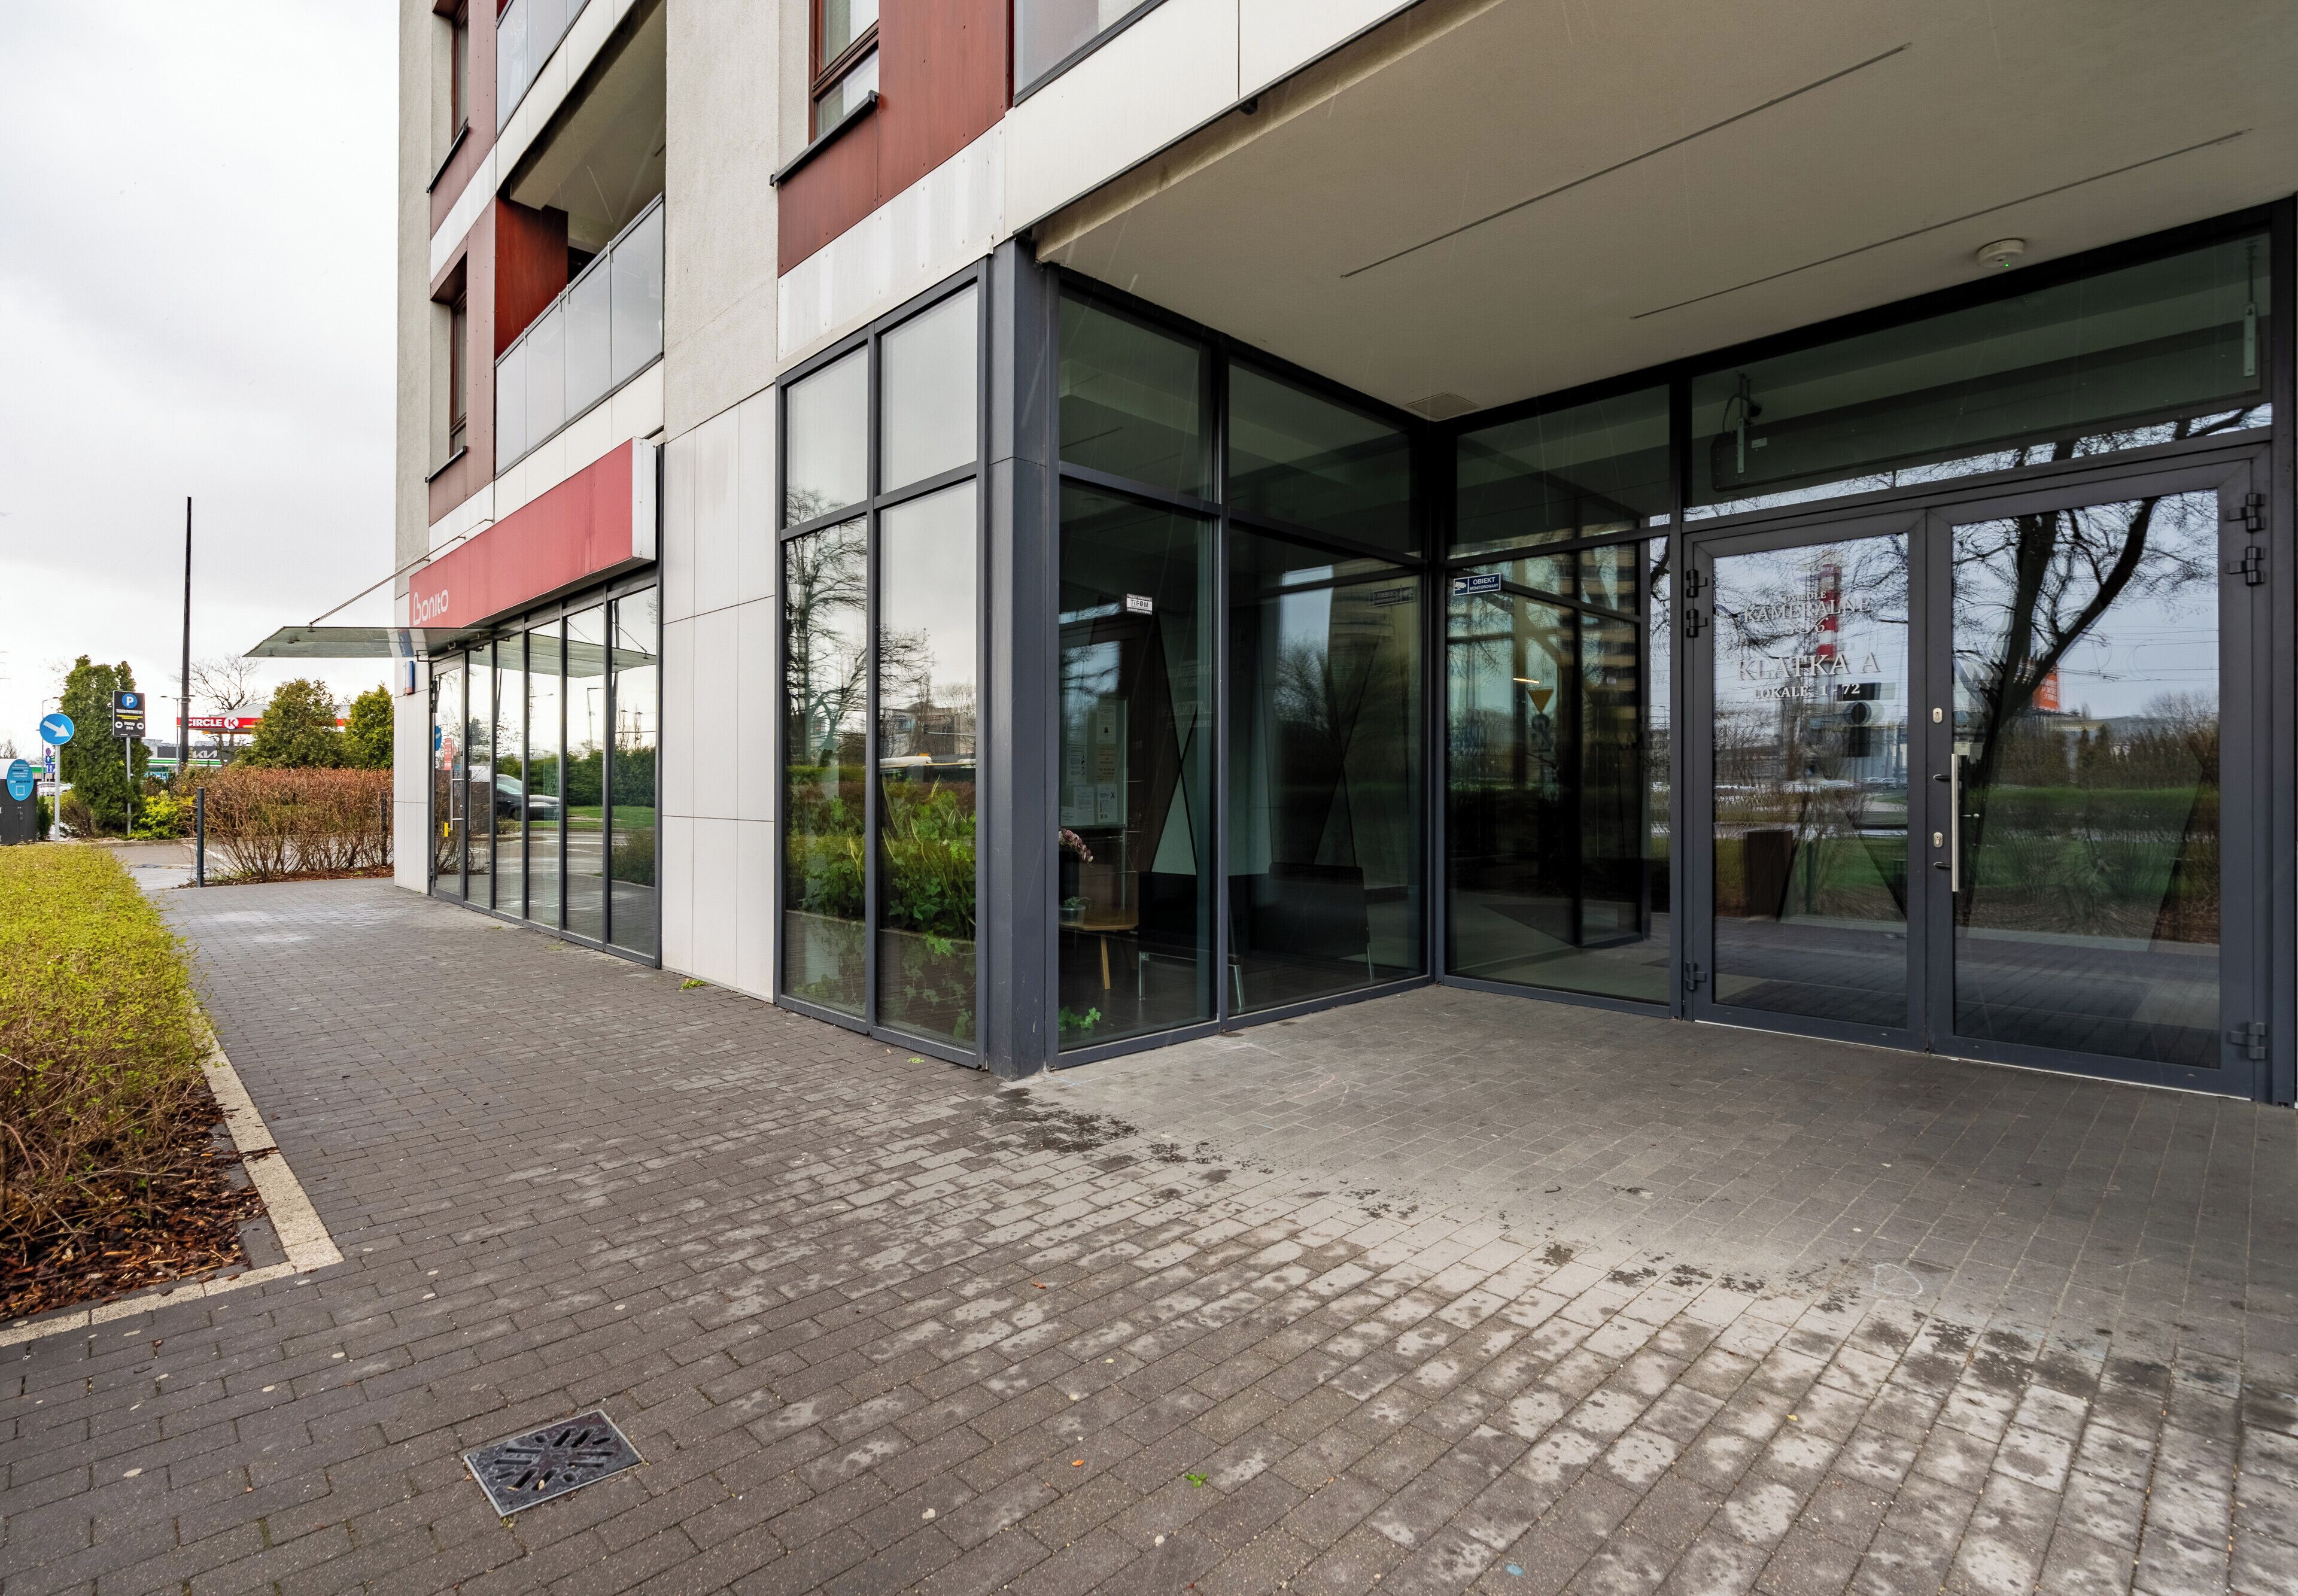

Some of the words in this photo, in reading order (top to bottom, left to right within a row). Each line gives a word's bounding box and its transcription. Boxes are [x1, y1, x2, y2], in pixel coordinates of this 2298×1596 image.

[1473, 576, 1495, 585] OBIEKT
[1744, 597, 1871, 623] KAMERALNE
[1737, 653, 1852, 681] KLATKA
[1859, 651, 1881, 674] A
[1755, 686, 1809, 699] LOKALE
[1820, 685, 1828, 696] 1
[1842, 683, 1861, 695] 72
[126, 696, 134, 706] P
[228, 719, 236, 728] K
